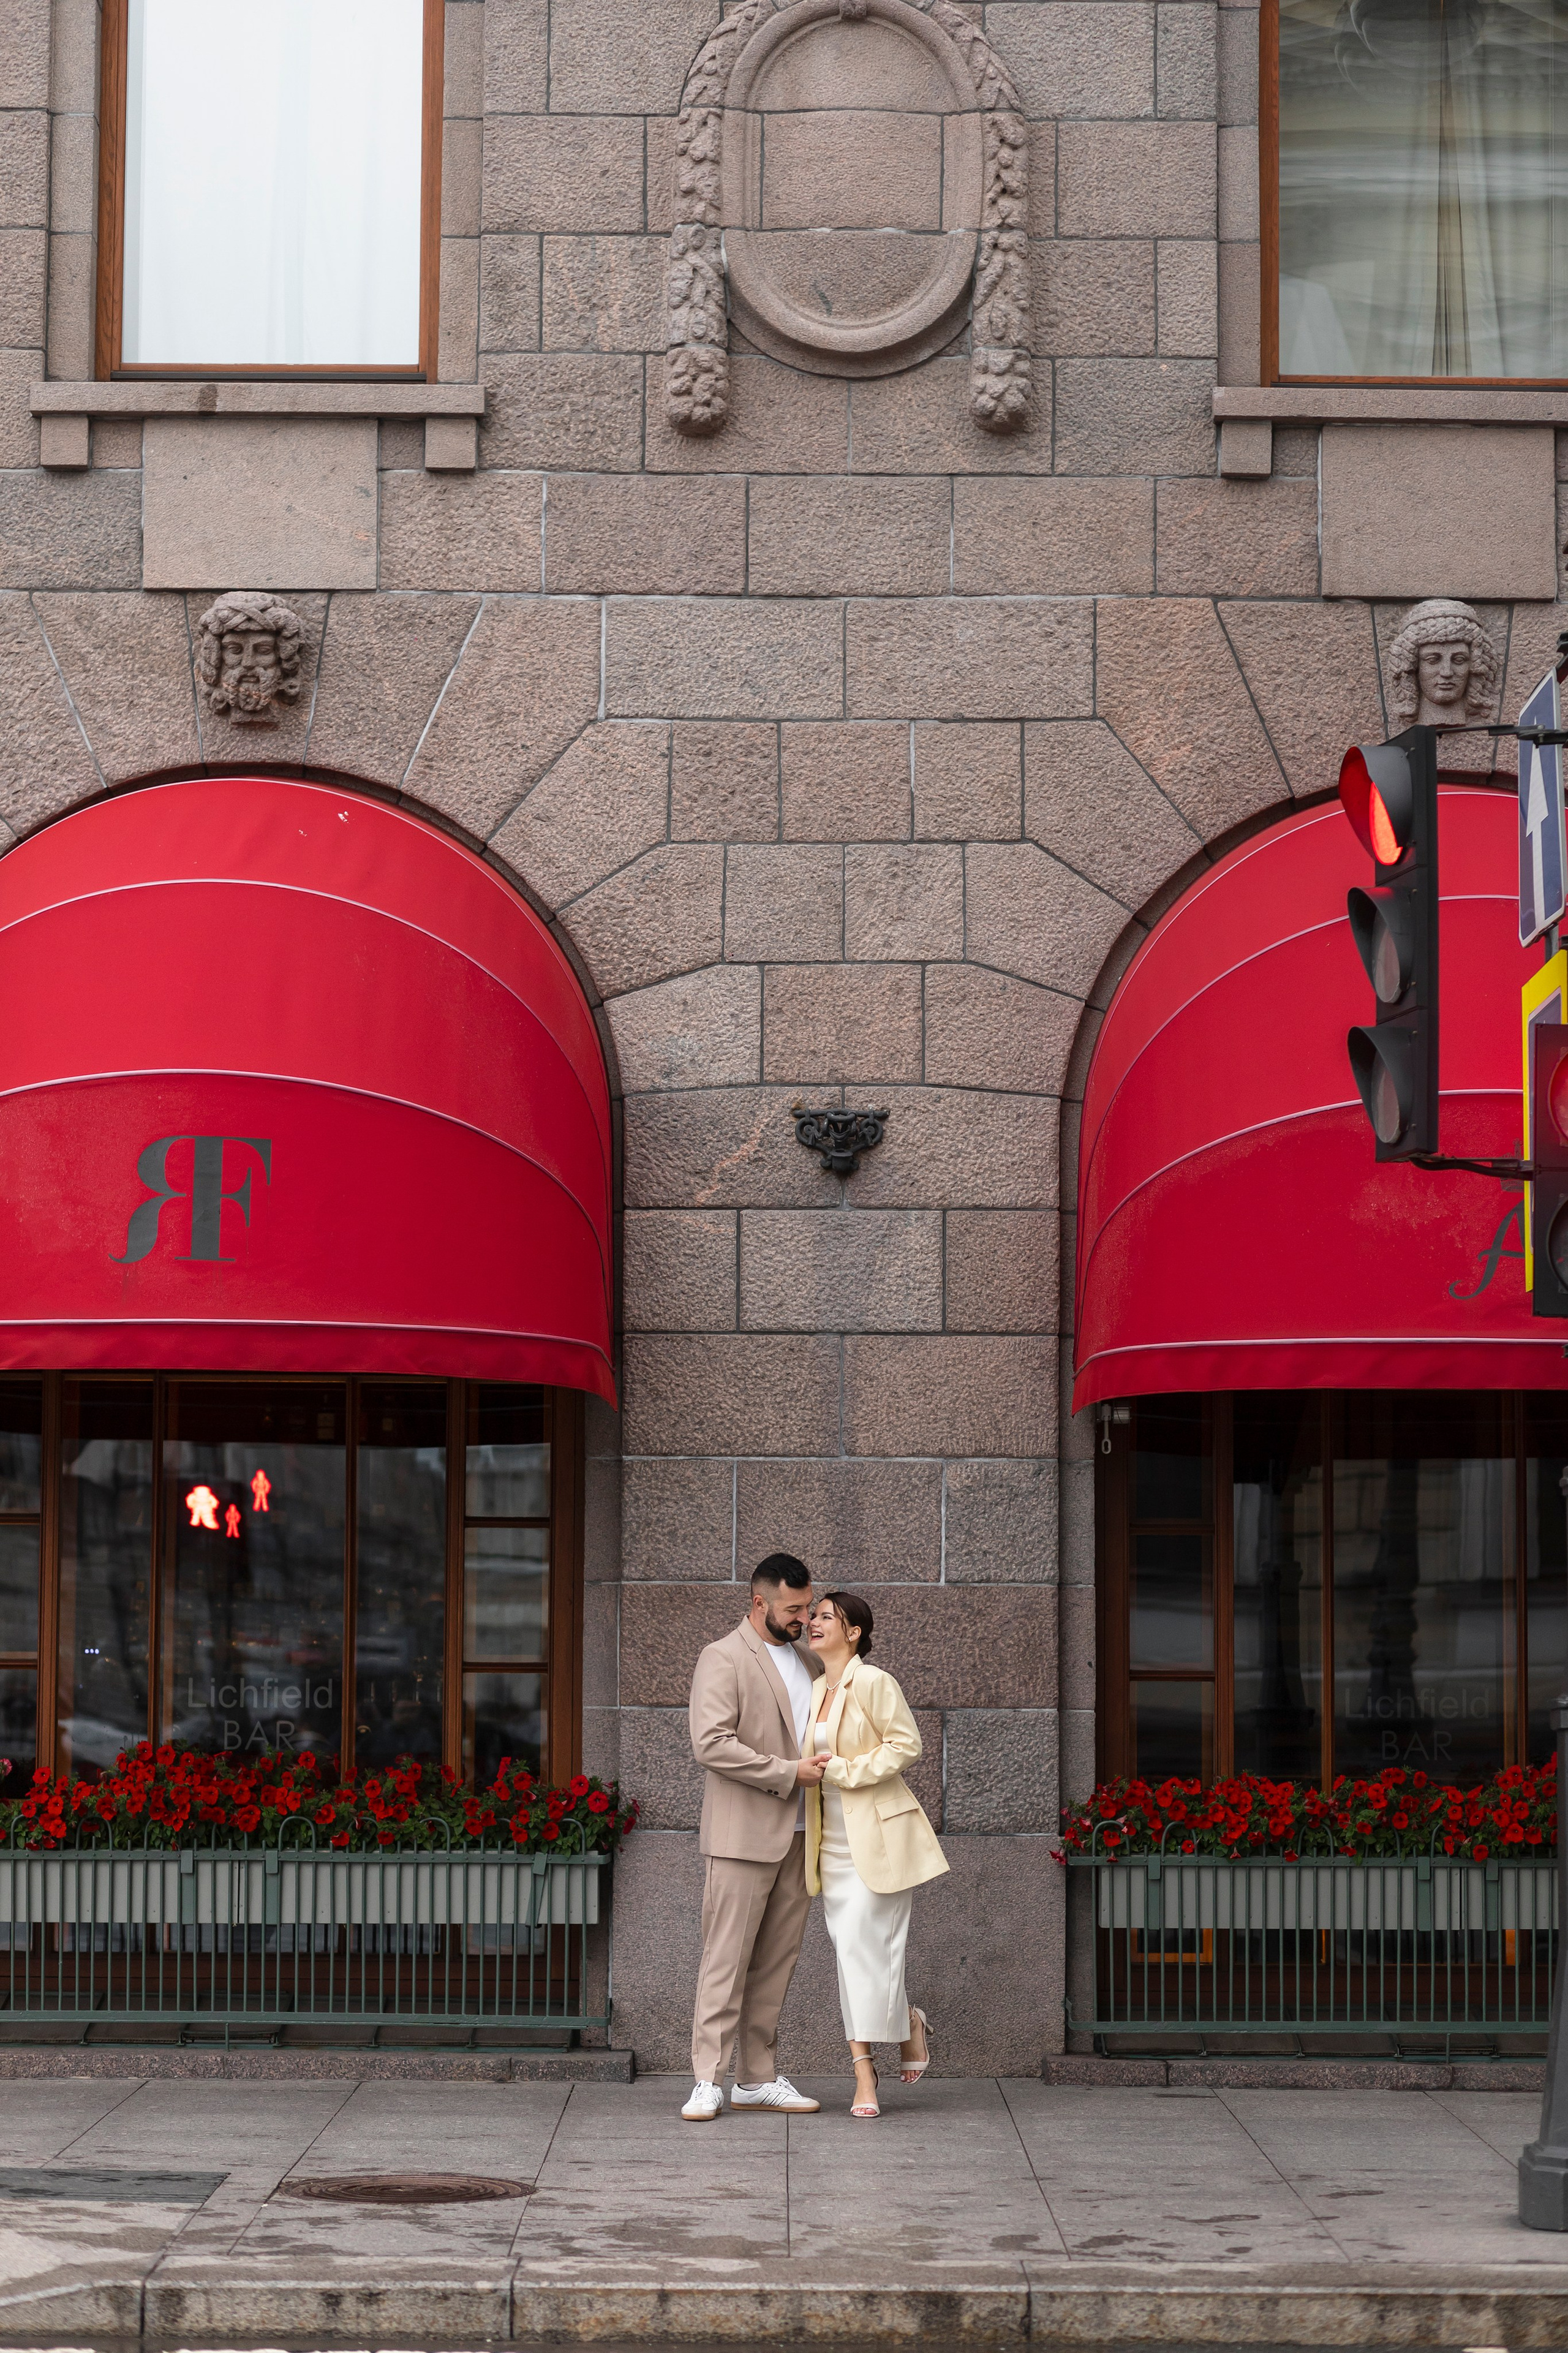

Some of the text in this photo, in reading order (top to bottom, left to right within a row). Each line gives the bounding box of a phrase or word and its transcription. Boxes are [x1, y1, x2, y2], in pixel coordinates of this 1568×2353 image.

[187, 1677, 333, 1709] Lichfield
[1344, 1687, 1490, 1719] Lichfield
[224, 1720, 295, 1750] BAR
[1381, 1731, 1453, 1761] BAR
